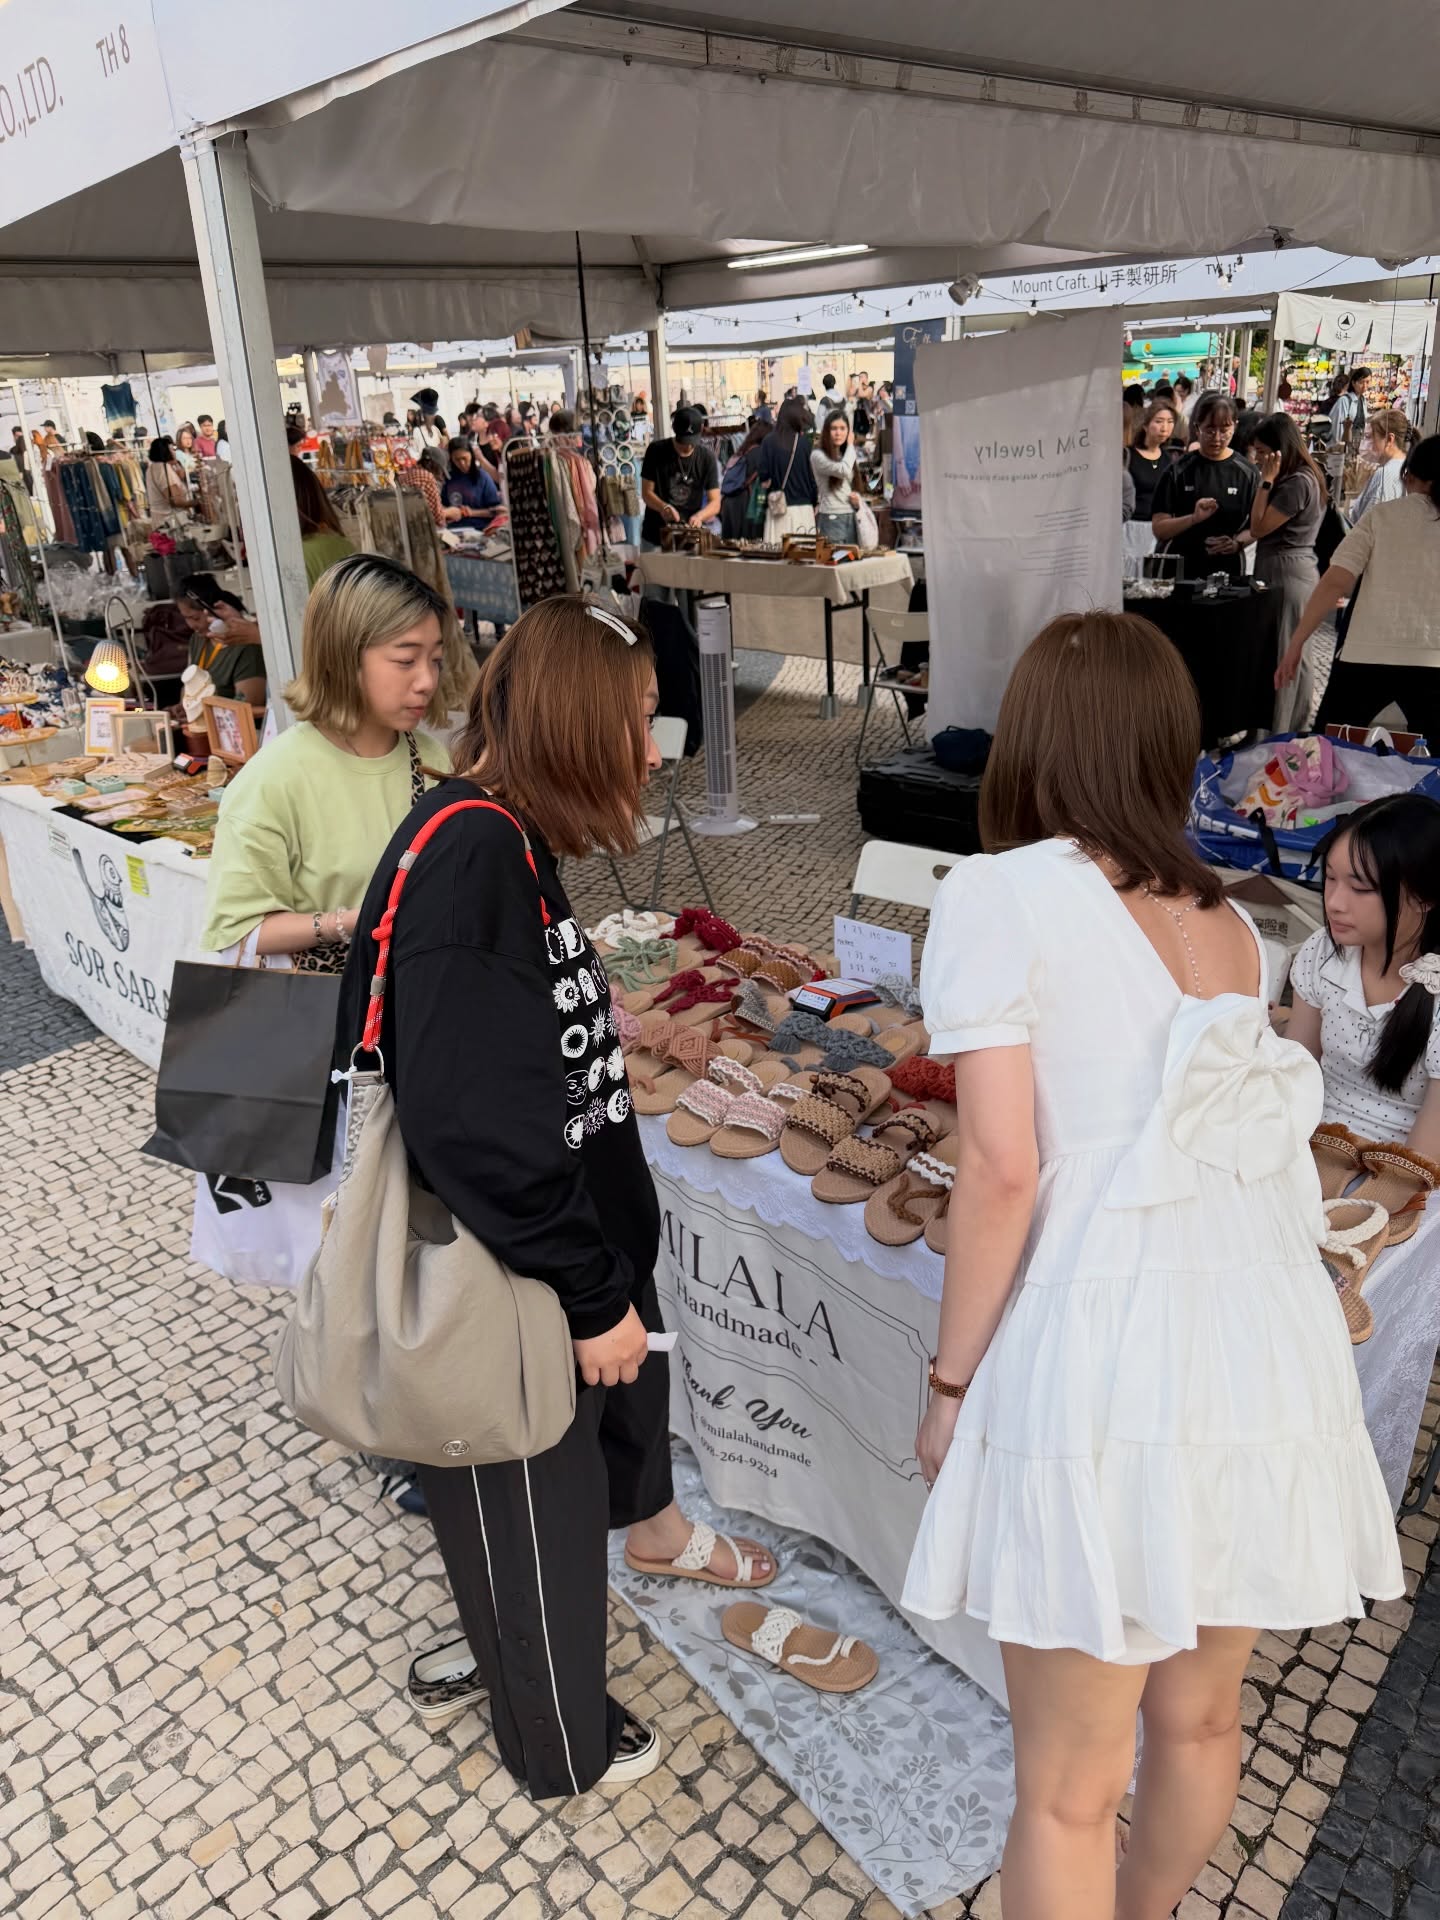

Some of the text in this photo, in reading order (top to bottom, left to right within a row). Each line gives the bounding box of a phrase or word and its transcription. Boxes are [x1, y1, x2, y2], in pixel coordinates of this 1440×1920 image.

[96, 32, 120, 78] TH
[119, 24, 131, 64] 8
[1012, 280, 1053, 295] Mount
[1056, 275, 1090, 292] Craft.
[822, 301, 853, 318] Ficelle
[64, 930, 111, 989] SOR
[675, 1274, 803, 1359] Handmade
[745, 1398, 814, 1439] You
